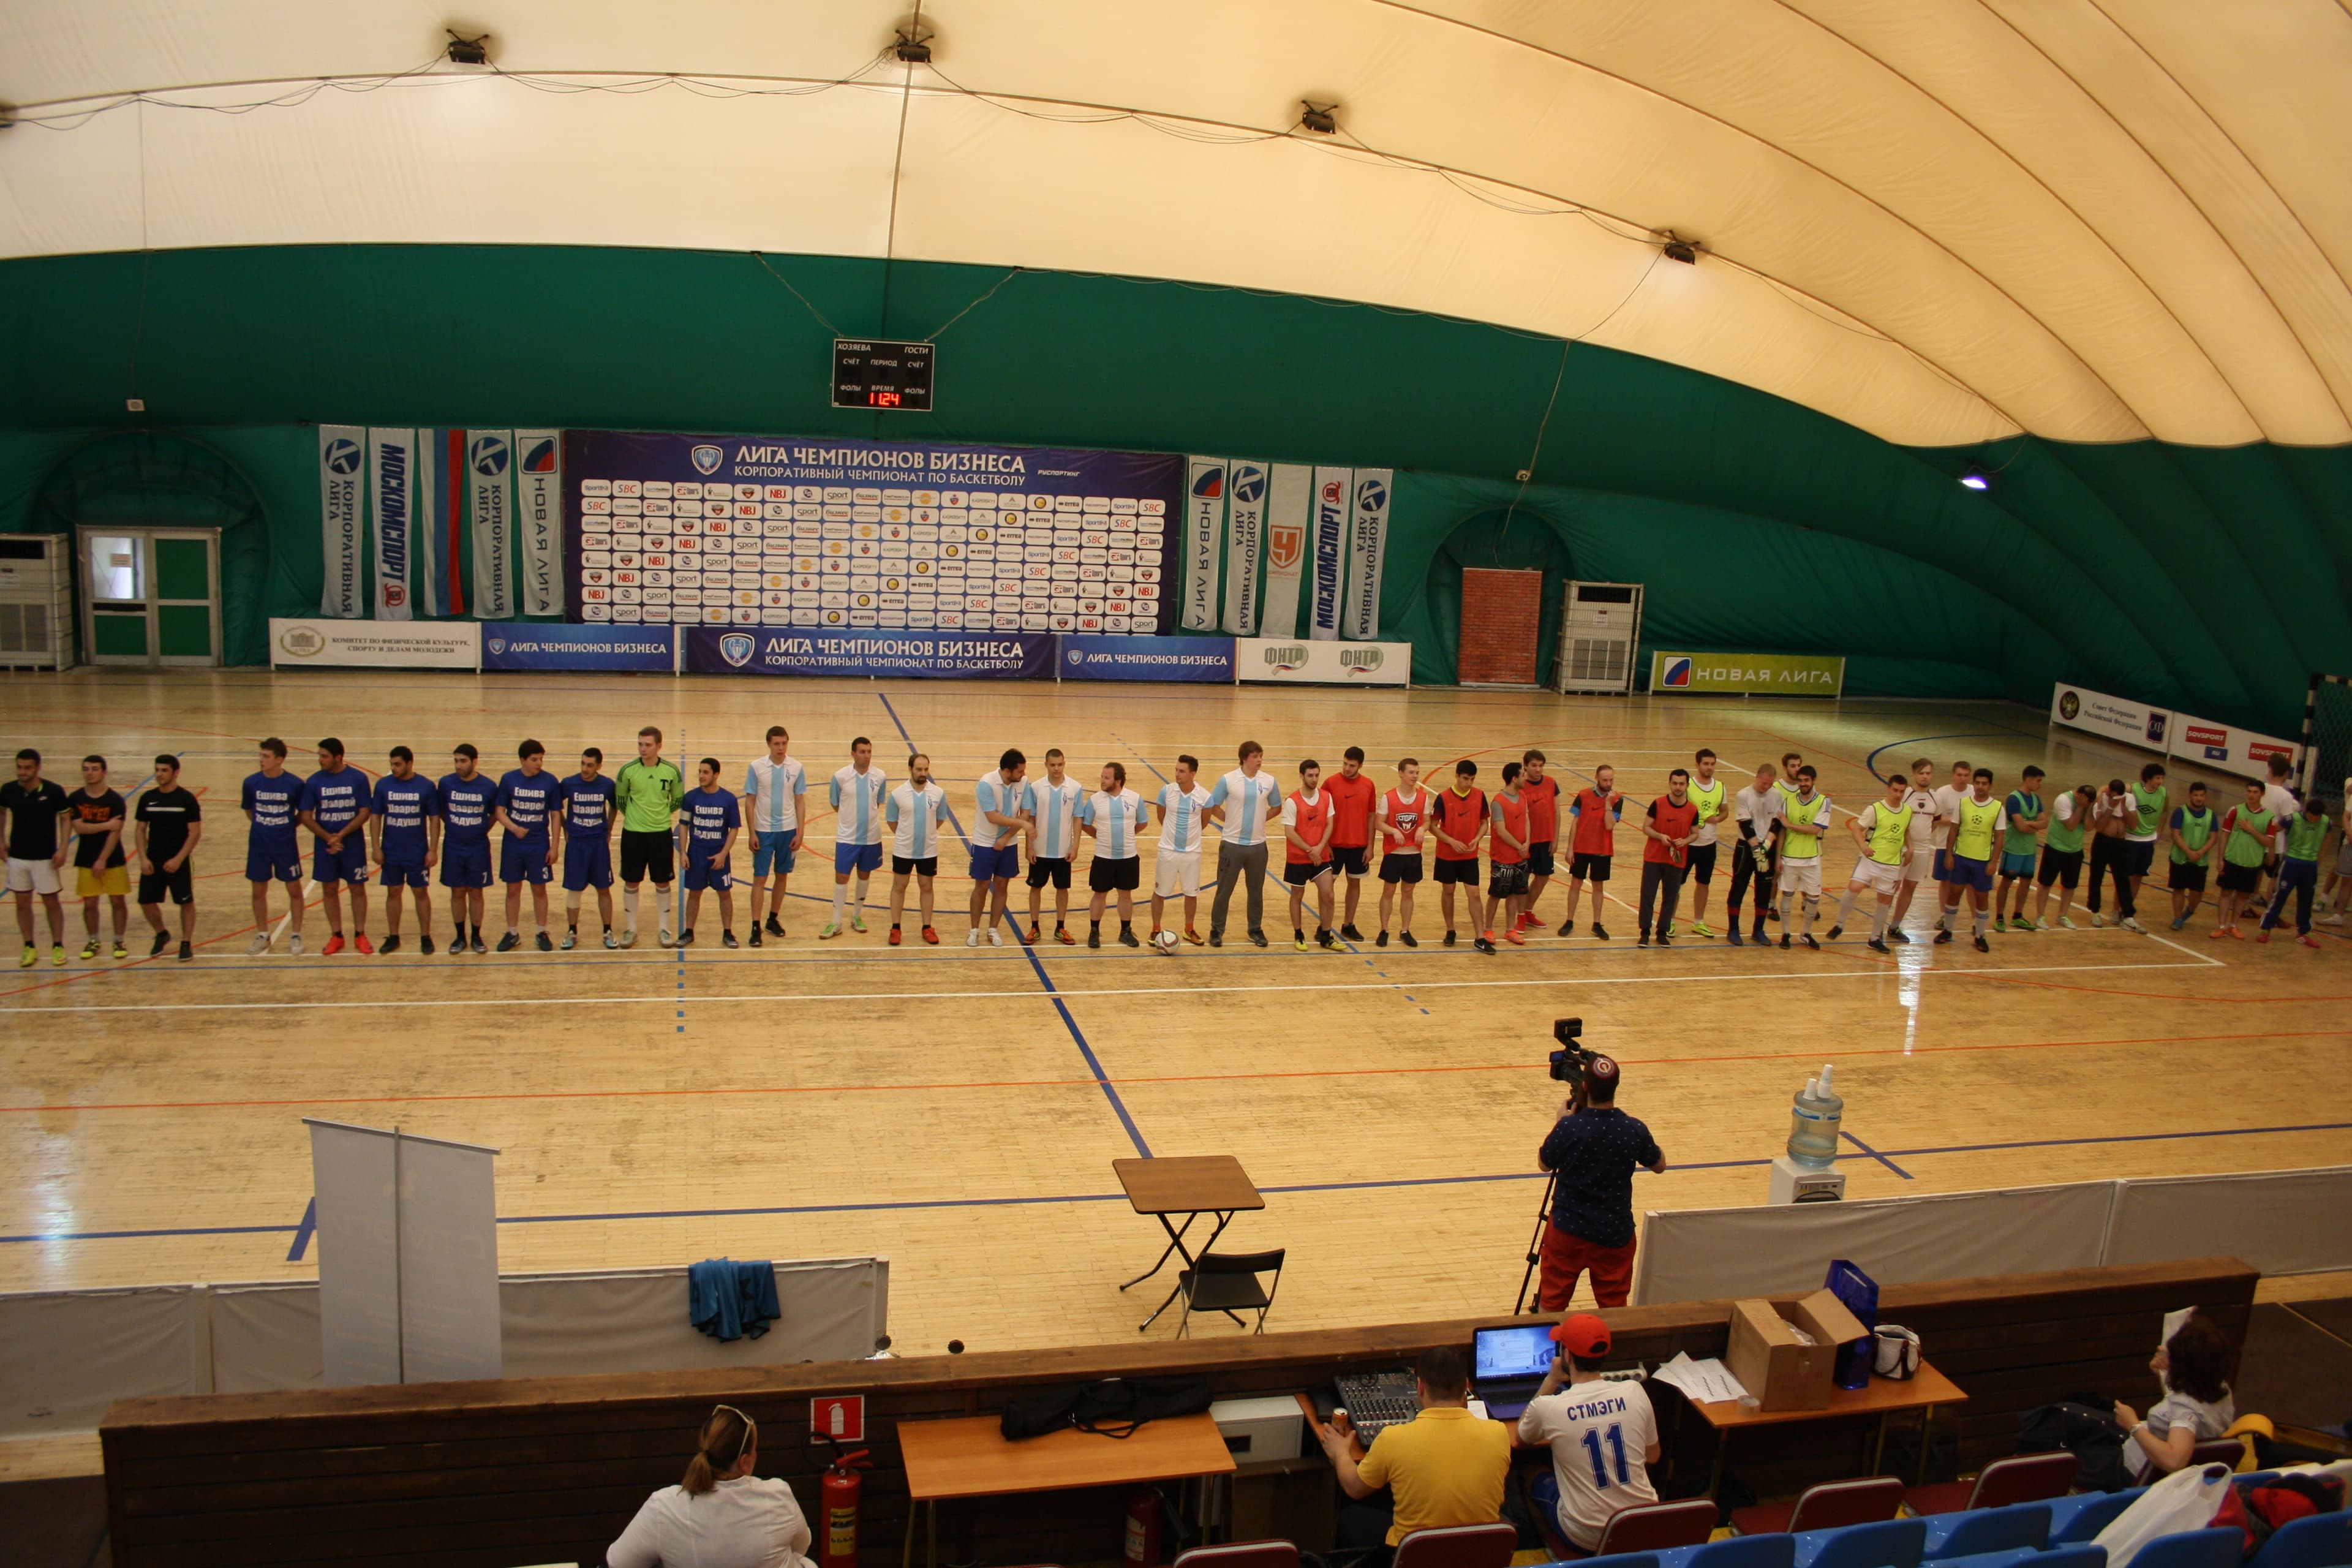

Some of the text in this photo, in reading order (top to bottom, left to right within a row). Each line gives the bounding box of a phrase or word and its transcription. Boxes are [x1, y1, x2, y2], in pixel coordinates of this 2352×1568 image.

[736, 445, 1026, 473] ЛИГА ЧЕМПИОНОВ БИЗНЕСА
[735, 466, 1025, 486] КОРПОРАТИВНЫЙ ЧЕМПИОНАТ ПО БАСКЕТБОЛУ
[618, 484, 636, 494] SBC
[770, 489, 786, 499] NBJ
[330, 480, 340, 520] ЛИГА
[827, 491, 848, 500] Sport
[479, 485, 489, 524] ЛИГА
[587, 502, 606, 511] SBC
[1144, 503, 1161, 512] SBC
[381, 443, 405, 582] МОСКОМСПОРТ
[739, 505, 755, 515] NBJ
[797, 508, 818, 516] Sport
[710, 522, 726, 532] NBJ
[768, 524, 788, 533] Sport
[1115, 519, 1132, 528] SBC
[1235, 510, 1245, 546] ЛИГА
[1357, 517, 1367, 552] ЛИГА
[342, 480, 354, 612] КОРПОРАТИВНАЯ
[492, 484, 504, 611] КОРПОРАТИВНАЯ
[534, 478, 549, 611] НОВАЯ ЛИГА
[679, 539, 695, 549] NBJ
[737, 541, 758, 549] Sport
[648, 556, 665, 566] NBJ
[707, 558, 727, 567] Sport
[1196, 502, 1211, 627] НОВАЯ ЛИГА
[1029, 567, 1046, 576] SBC
[1240, 511, 1256, 629] КОРПОРАТИВНАЯ
[1317, 504, 1341, 629] МОСКОМСПОРТ
[618, 573, 634, 582] NBJ
[676, 575, 698, 584] Sport
[1360, 516, 1378, 635] КОРПОРАТИВНАЯ
[1000, 584, 1017, 592] SBC
[1138, 587, 1153, 596] NBJ
[588, 589, 604, 599] NBJ
[647, 592, 667, 600] Sport
[970, 600, 987, 608] SBC
[1110, 603, 1125, 611] NBJ
[616, 608, 636, 617] Sport
[941, 616, 959, 624] SBC
[1083, 619, 1097, 628] NBJ
[510, 643, 666, 654] ЛИГА ЧЕМПИОНОВ БИЗНЕСА
[766, 638, 1023, 657] ЛИГА ЧЕМПИОНОВ БИЗНЕСА
[765, 655, 1023, 669] КОРПОРАТИВНЫЙ ЧЕМПИОНАТ ПО БАСКЕТБОЛУ
[1087, 654, 1227, 665] ЛИГА ЧЕМПИОНОВ БИЗНЕСА
[1696, 668, 1833, 684] НОВАЯ ЛИГА
[2187, 731, 2225, 741] SOVSPORT
[255, 790, 287, 801] Ешива
[321, 786, 352, 796] Ешива
[388, 791, 420, 801] Ешива
[450, 790, 483, 802] Ешива
[514, 786, 545, 798] Ешива
[574, 792, 604, 802] Ешива
[695, 805, 723, 815] Ешива
[354, 865, 368, 880] 29
[1567, 1397, 1626, 1420] СТМЭГИ
[1581, 1422, 1630, 1490] 11
